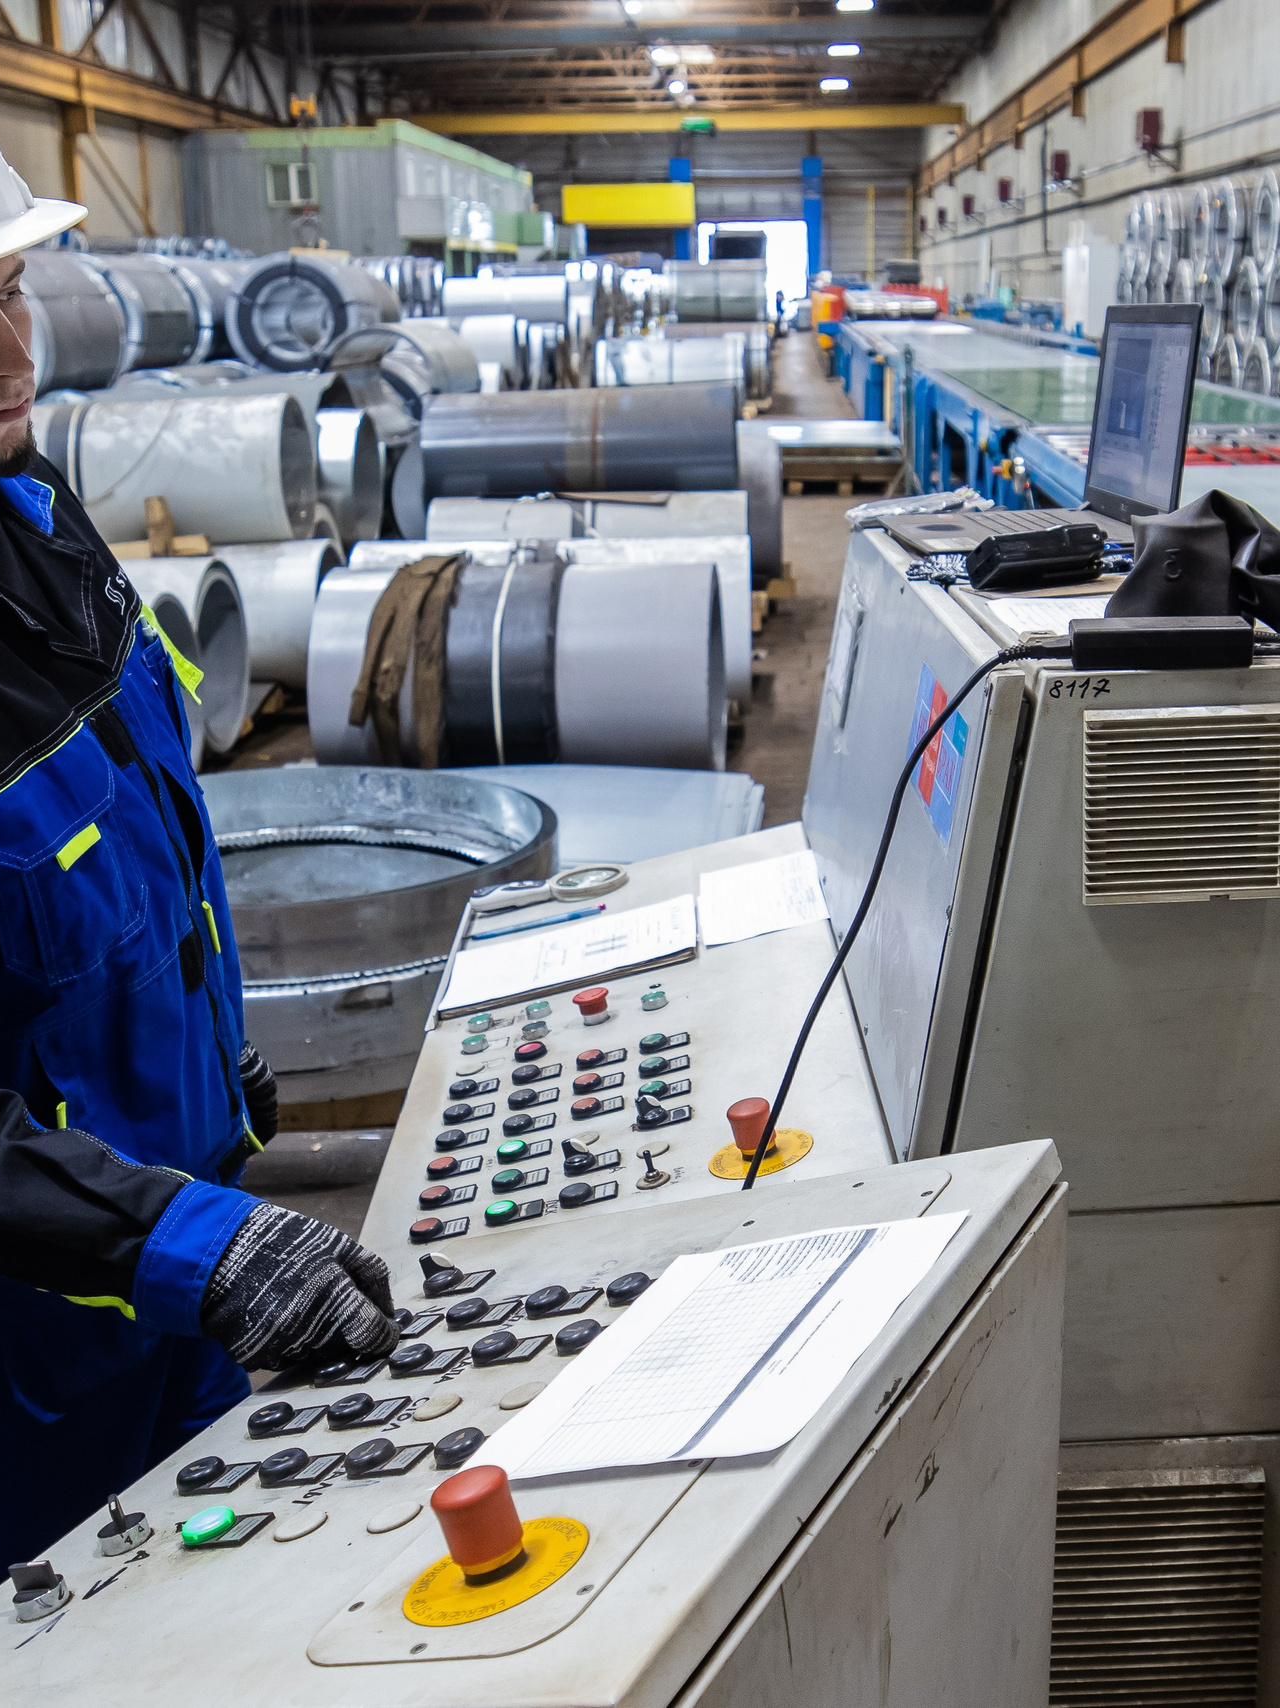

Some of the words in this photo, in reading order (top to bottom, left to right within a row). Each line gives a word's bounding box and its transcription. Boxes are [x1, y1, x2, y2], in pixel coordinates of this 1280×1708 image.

[1049, 677, 1111, 699] 8117
[291, 1464, 346, 1504] АЛЫ
[413, 1557, 453, 1594] EMERGE
[423, 1599, 506, 1622] EMERGENCY
